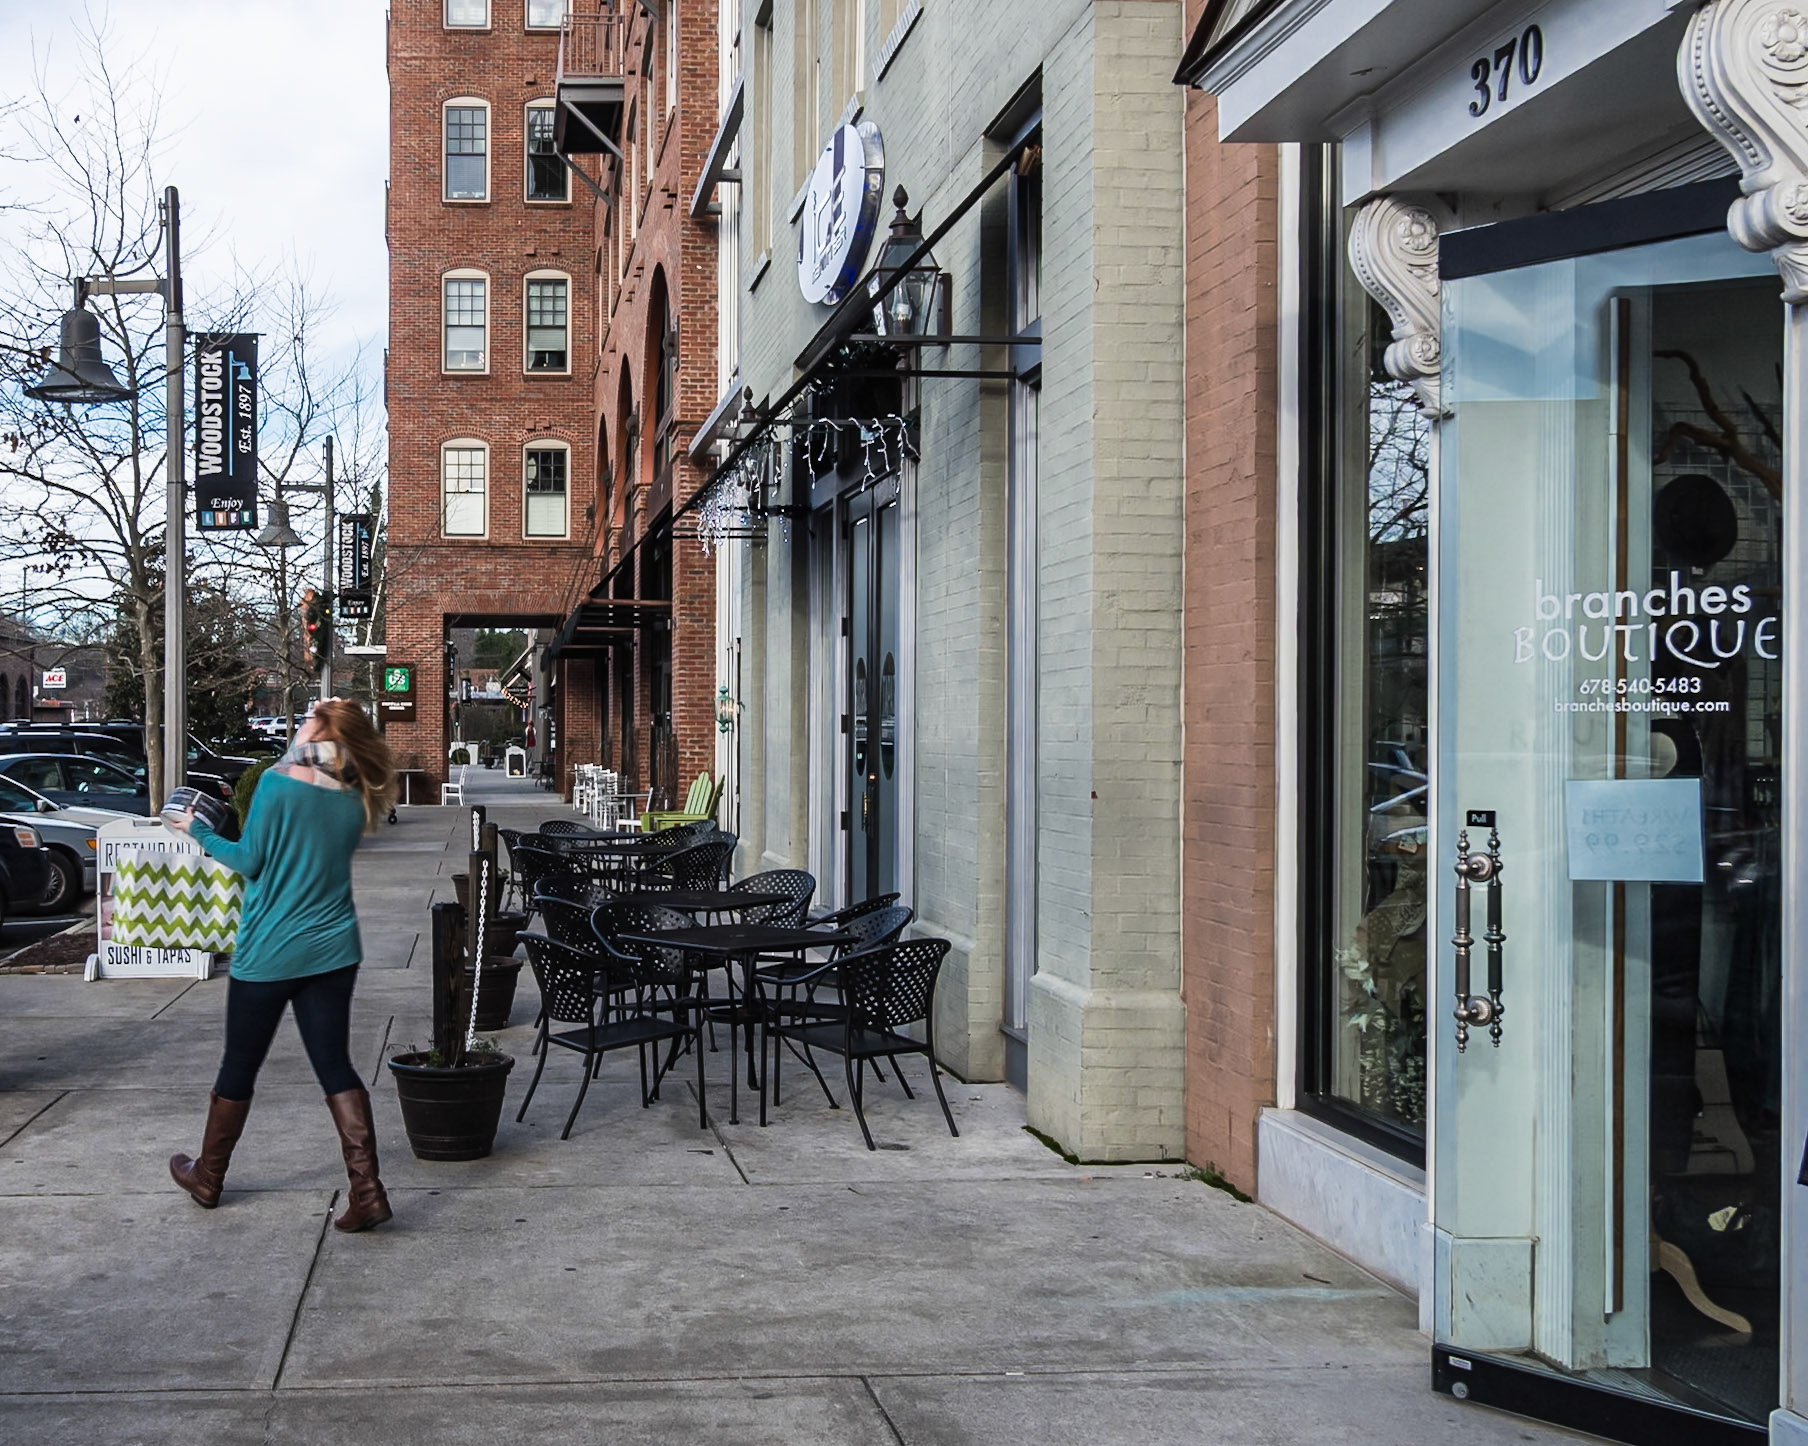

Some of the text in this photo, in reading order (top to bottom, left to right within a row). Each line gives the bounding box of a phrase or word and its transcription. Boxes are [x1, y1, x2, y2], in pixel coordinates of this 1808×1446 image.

[1469, 23, 1543, 117] 370
[199, 350, 223, 476] WOODSTOCK
[238, 384, 253, 454] Est. 1897
[210, 496, 244, 511] Enjoy
[340, 522, 354, 590] WOODSTOCK
[1535, 570, 1752, 620] branches
[1513, 616, 1779, 669] BOUTIQUE
[45, 673, 65, 682] ACE
[1579, 677, 1702, 695] 678-540-5483
[1553, 697, 1730, 716] branchesboutique.com
[1471, 813, 1487, 823] Pull
[107, 946, 142, 965] SUSHI
[146, 950, 152, 964] &
